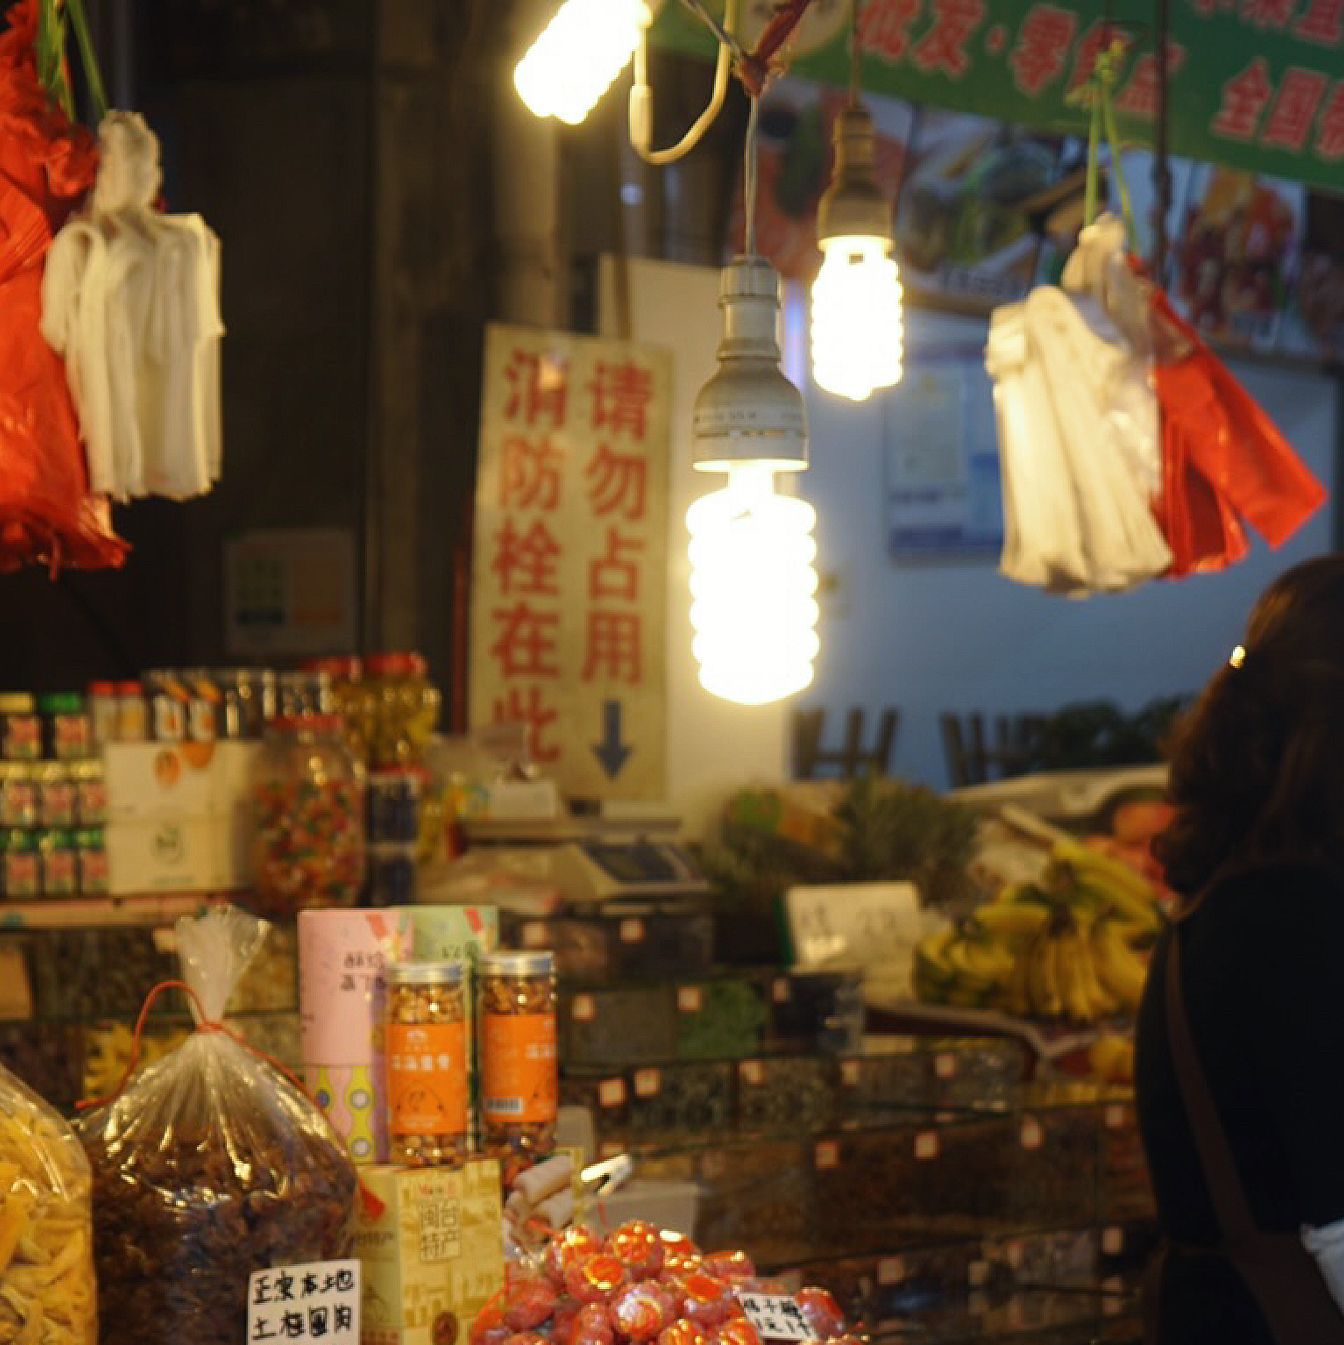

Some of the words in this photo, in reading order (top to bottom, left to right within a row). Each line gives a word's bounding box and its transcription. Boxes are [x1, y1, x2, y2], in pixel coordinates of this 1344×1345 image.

[489, 345, 571, 763] 消防栓在此
[579, 357, 655, 690] 请勿占用
